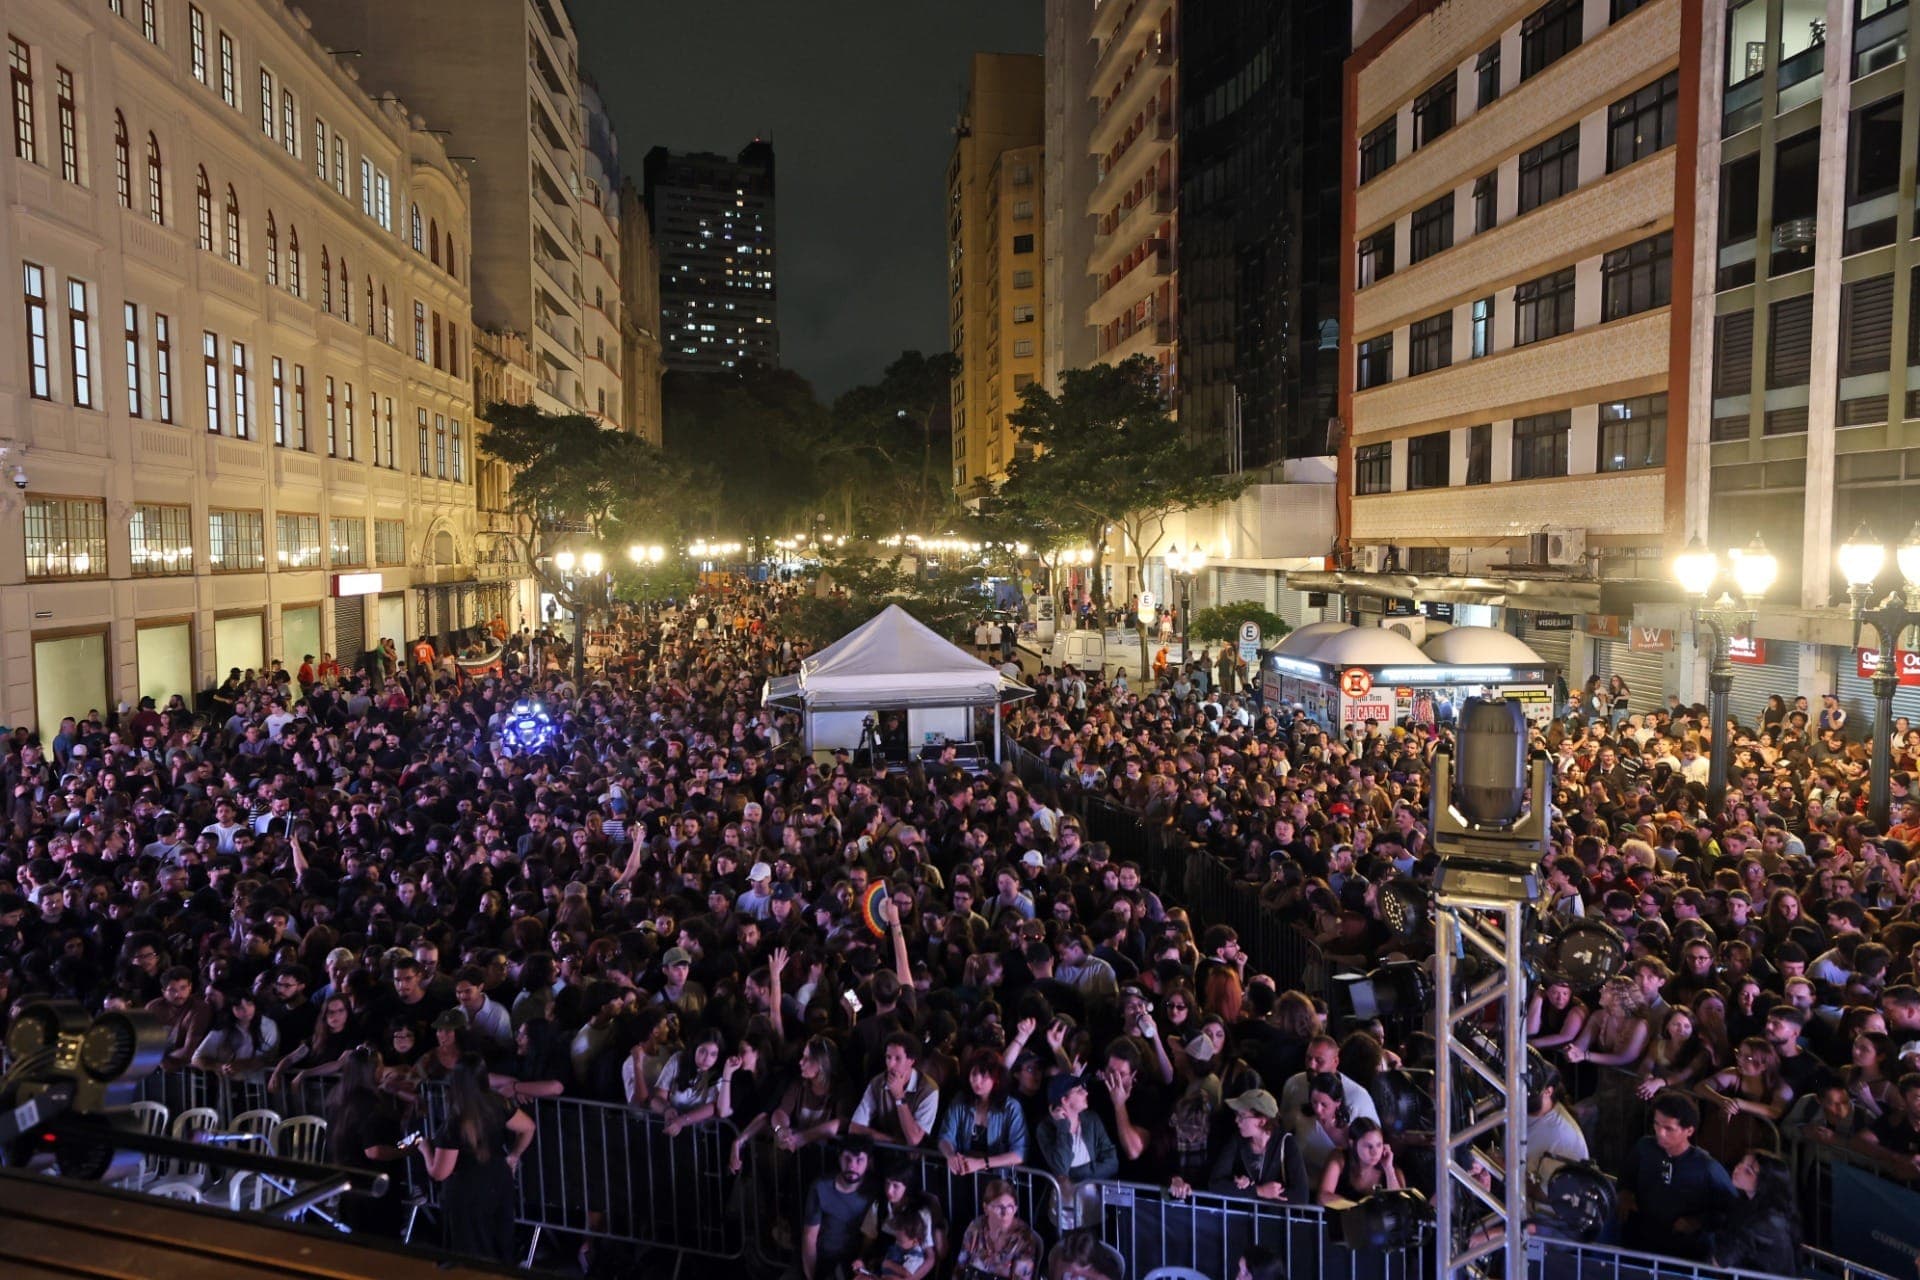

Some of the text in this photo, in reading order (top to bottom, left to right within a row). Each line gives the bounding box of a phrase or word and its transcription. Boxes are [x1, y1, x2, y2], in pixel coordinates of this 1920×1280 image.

[1144, 595, 1150, 604] E
[1246, 626, 1253, 637] E
[1345, 705, 1387, 720] RCARGA
